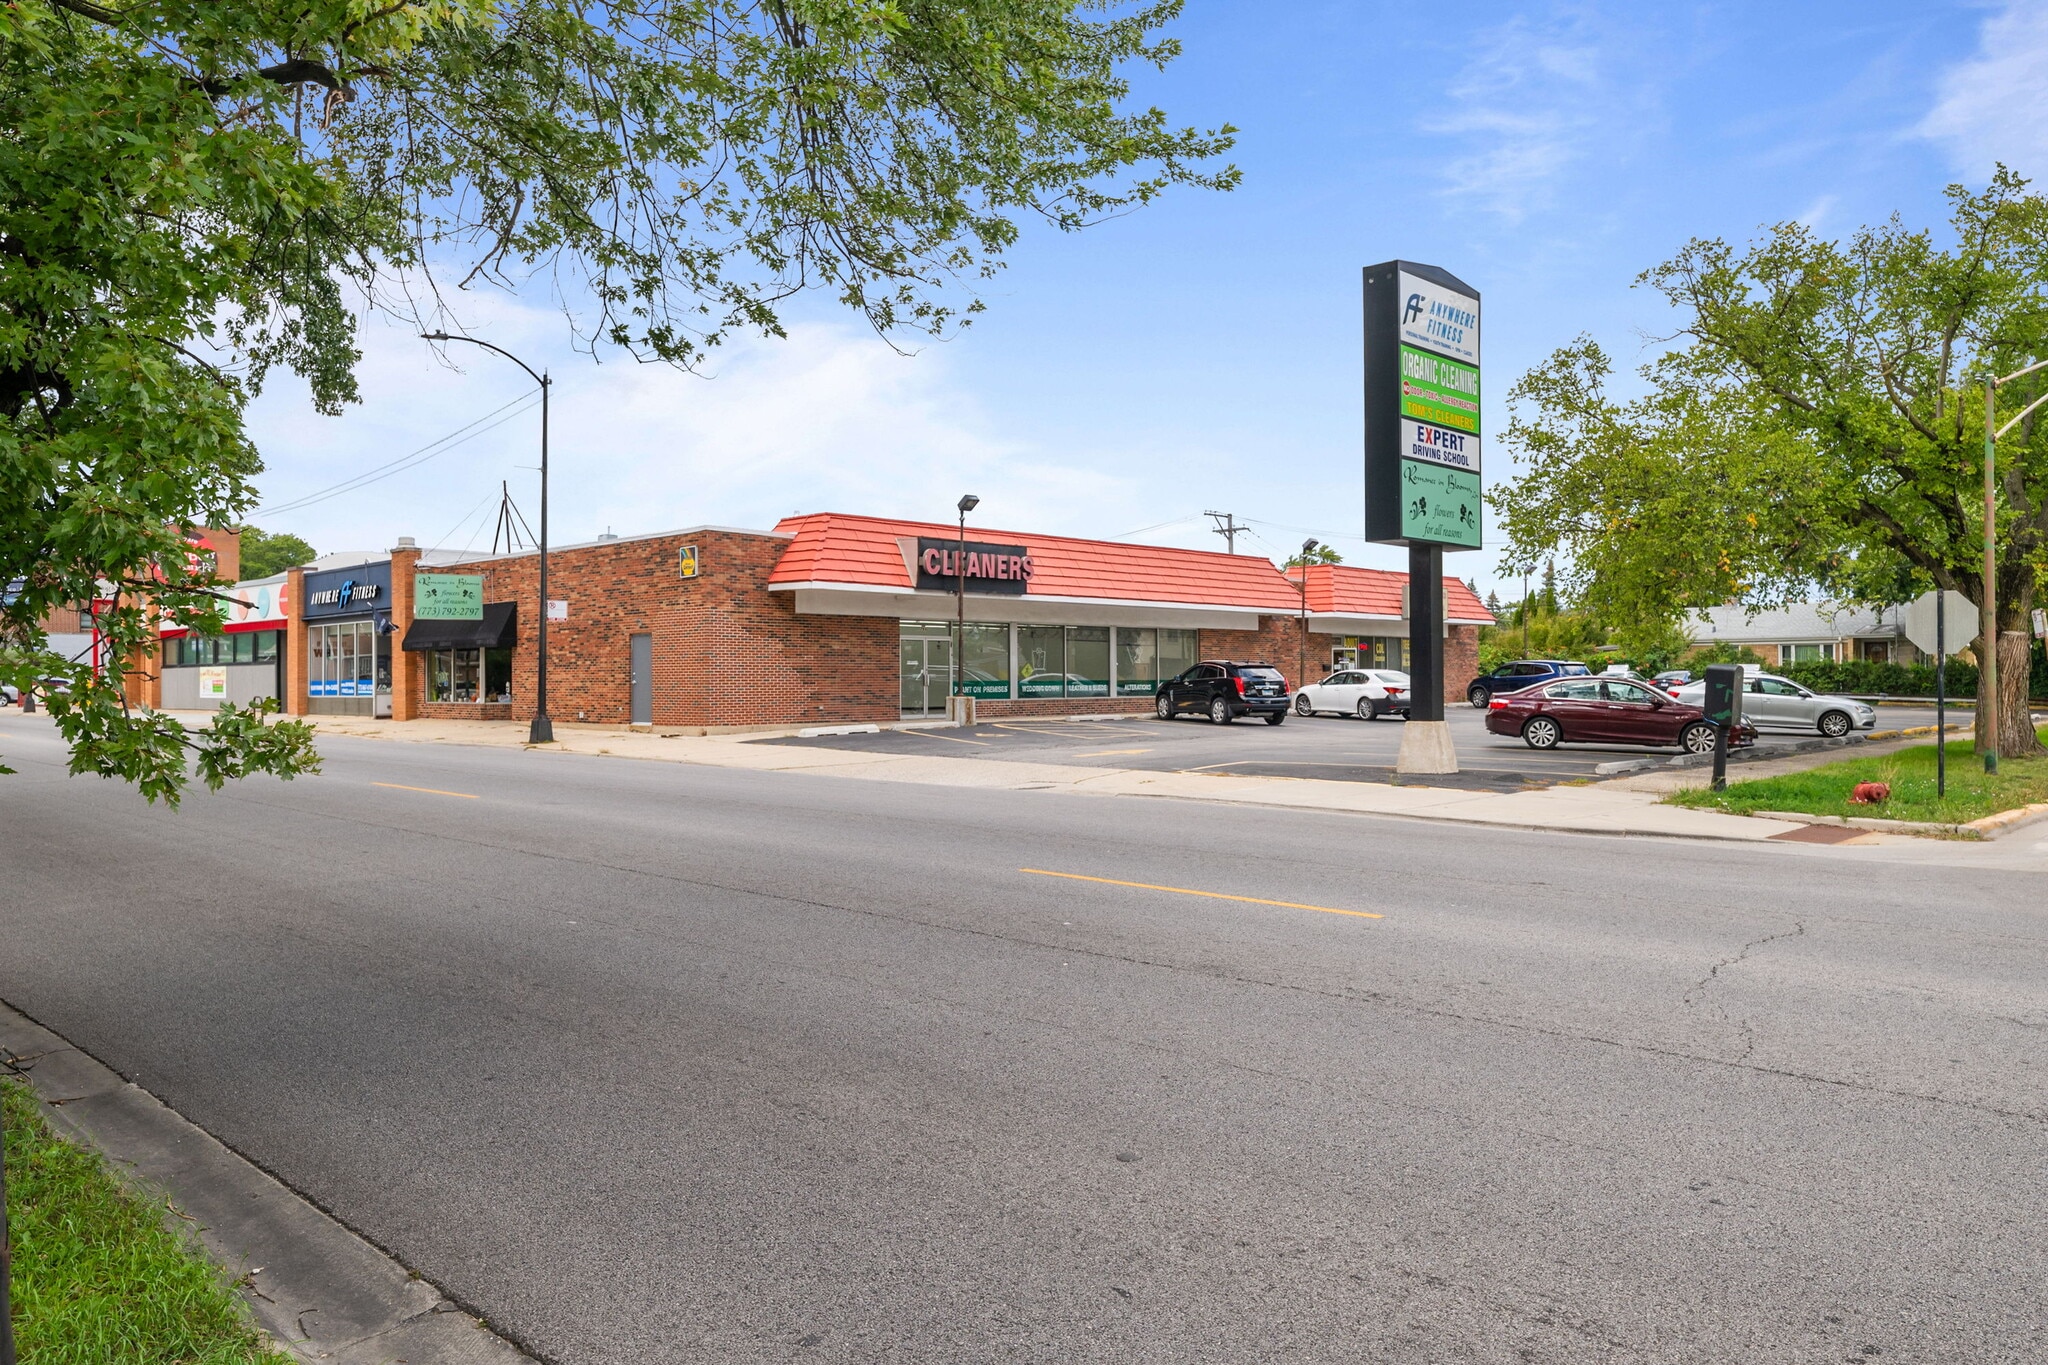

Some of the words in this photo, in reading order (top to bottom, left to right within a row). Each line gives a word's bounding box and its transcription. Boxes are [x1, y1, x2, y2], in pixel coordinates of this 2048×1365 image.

[1429, 300, 1476, 330] ANYWHERE
[1426, 319, 1464, 344] FITNESS
[1402, 351, 1438, 384] ORGANIC
[1440, 362, 1477, 396] CLEANING
[1407, 401, 1433, 419] TOM'S
[1435, 409, 1474, 430] CLEANERS
[1417, 425, 1465, 452] EXPERT
[1412, 443, 1441, 460] DRIVING
[1443, 450, 1470, 467] SCHOOL
[1403, 465, 1436, 485] Romance
[1433, 504, 1456, 519] flowers
[1422, 522, 1433, 537] for
[1433, 523, 1443, 535] all
[1442, 528, 1463, 539] reasons
[922, 548, 1035, 580] CLEANERS
[310, 589, 339, 605] ANYWHERE
[352, 585, 377, 600] FITNESS
[441, 589, 460, 597] flowers
[418, 607, 440, 617] (773)
[441, 607, 480, 616] 792-2797
[982, 685, 1008, 693] PREMISES
[1124, 683, 1152, 691] ALTERATIONS
